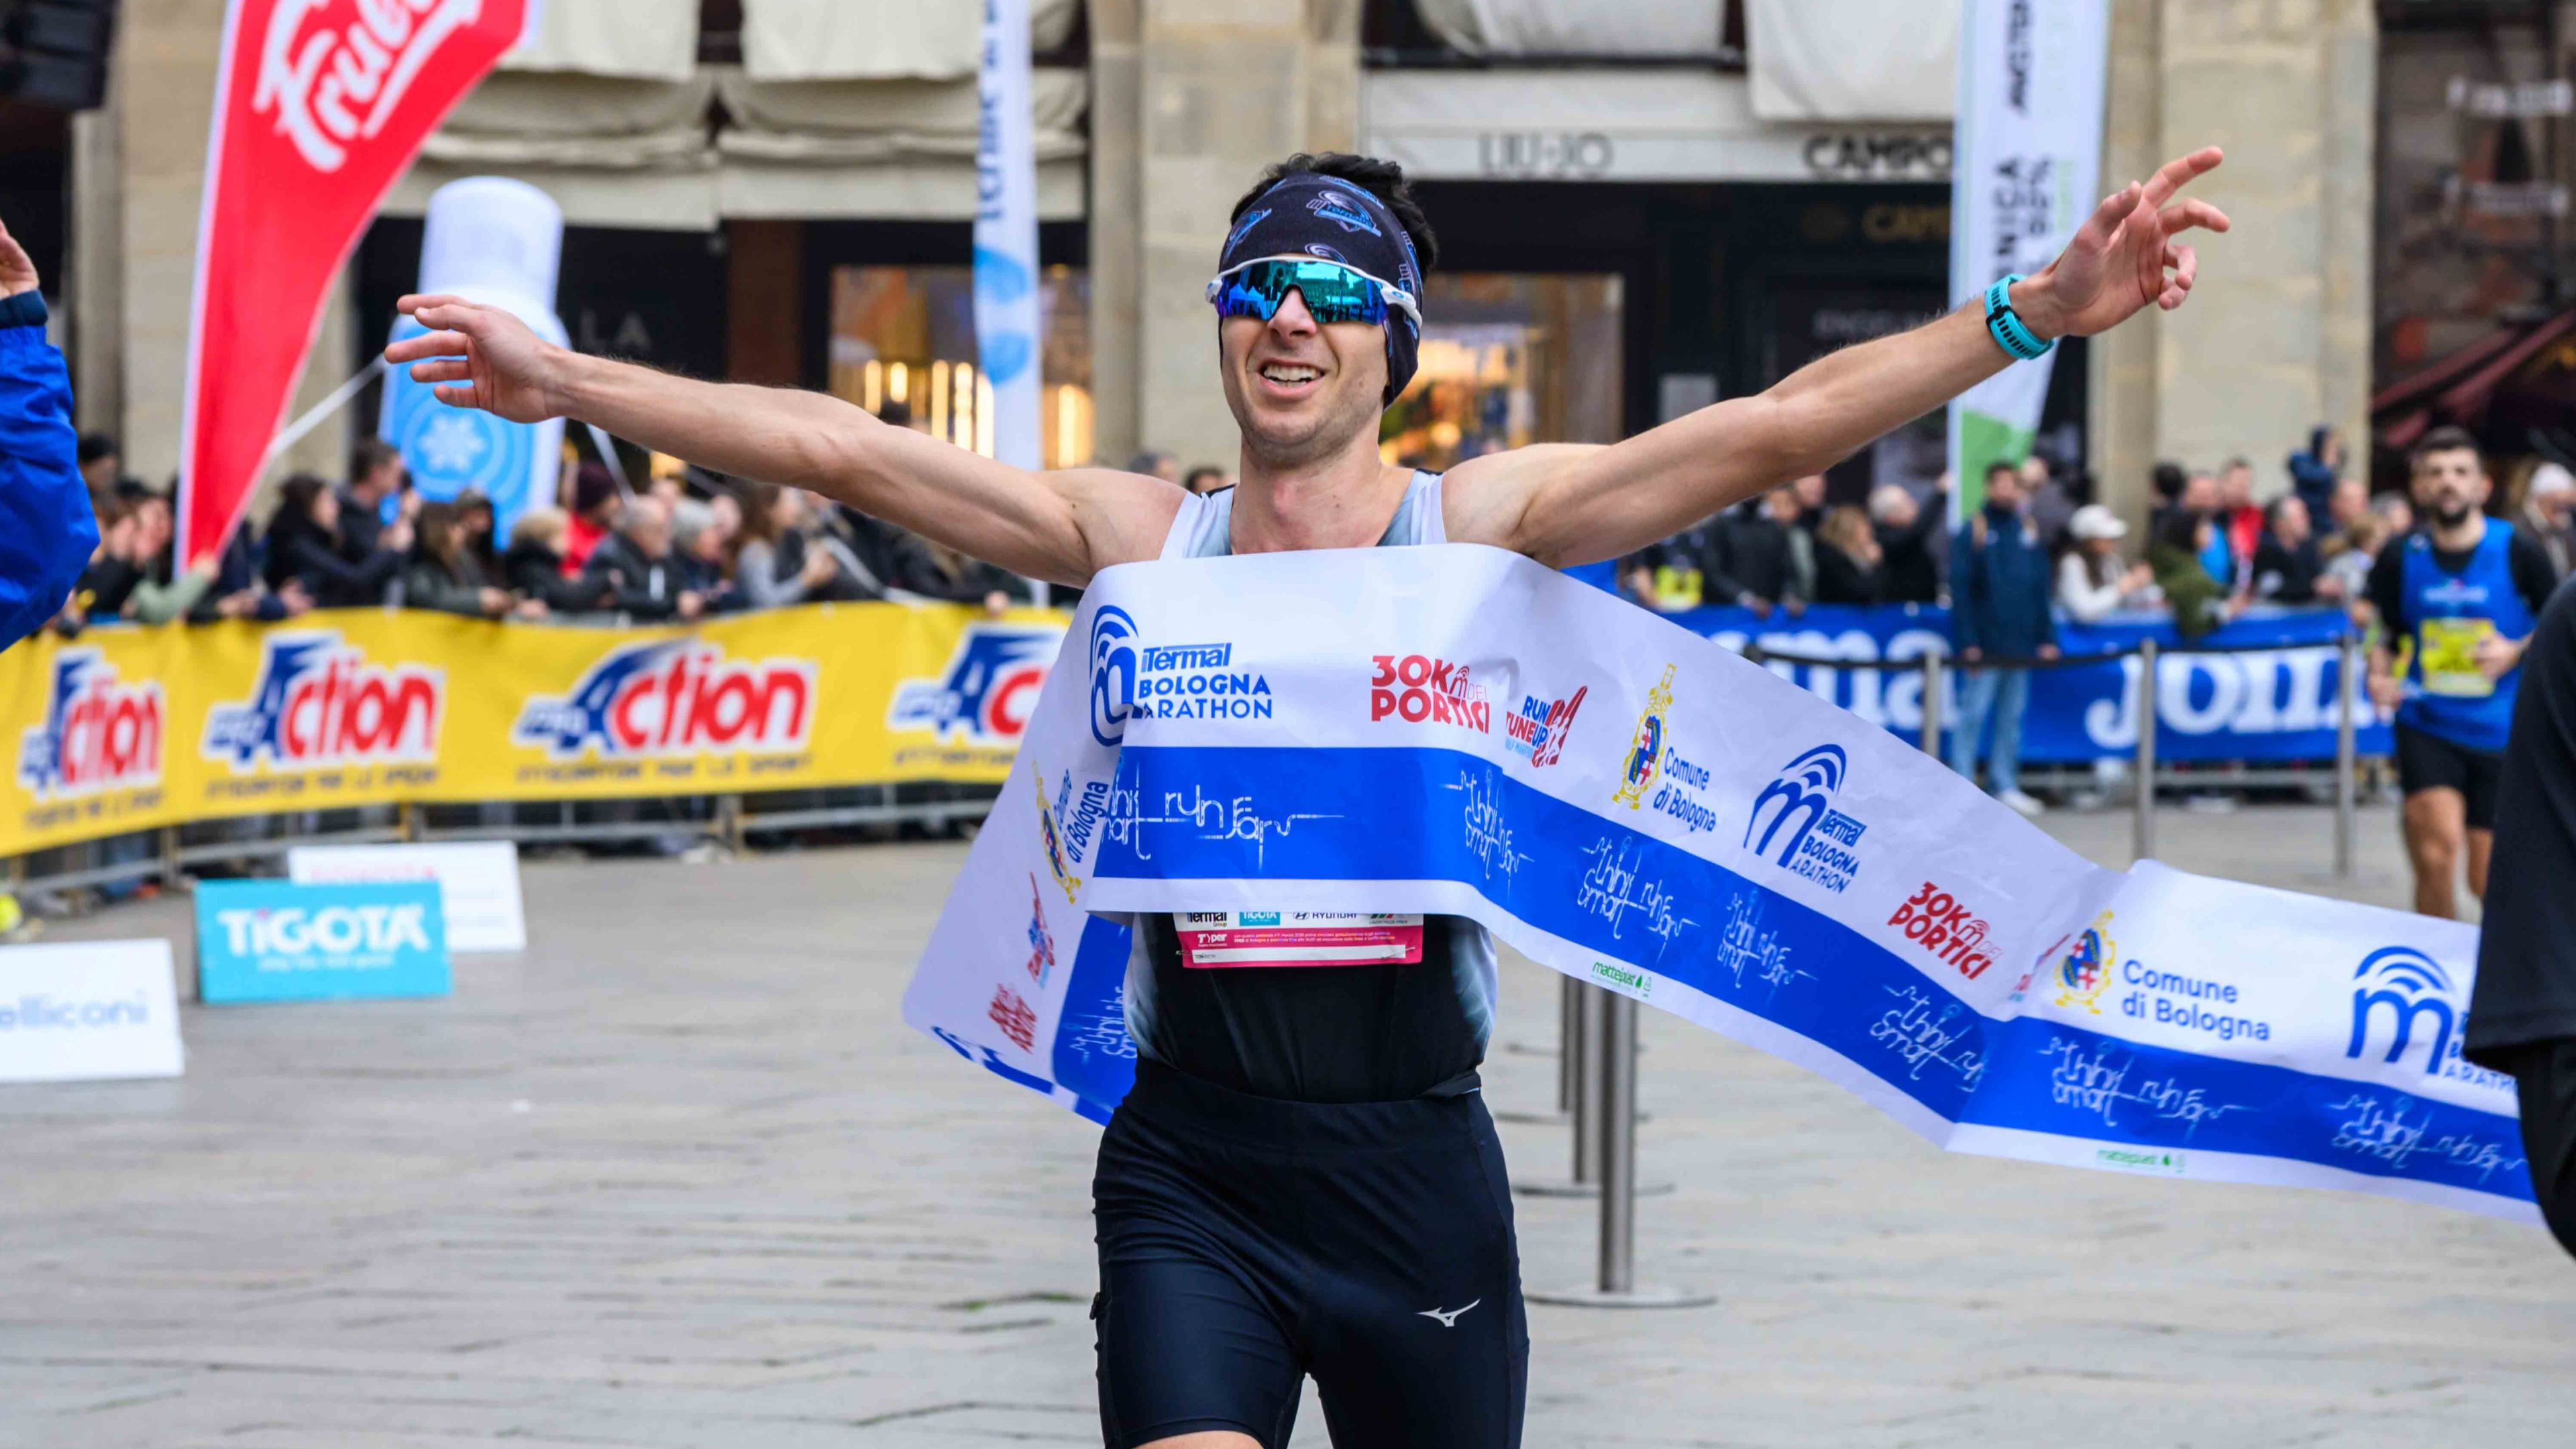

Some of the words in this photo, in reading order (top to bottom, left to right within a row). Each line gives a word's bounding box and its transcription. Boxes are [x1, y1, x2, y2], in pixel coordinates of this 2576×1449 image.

[1138, 674, 1272, 699] BOLOGNA
[1372, 655, 1454, 695] 30K
[1371, 688, 1490, 735] PORTICI
[1521, 695, 1551, 724] RUN
[1532, 723, 1548, 749] UP
[1664, 747, 1710, 791] Comune
[1067, 781, 1109, 848] Bologna
[1653, 782, 1672, 812] di
[1670, 791, 1717, 833] Bologna
[1801, 835, 1860, 877] BOLOGNA
[1908, 881, 1972, 932] 30K
[1887, 902, 1992, 980] PORTICI
[2123, 959, 2239, 1004] Comune
[2122, 991, 2145, 1019] di
[2156, 998, 2271, 1041] Bologna
